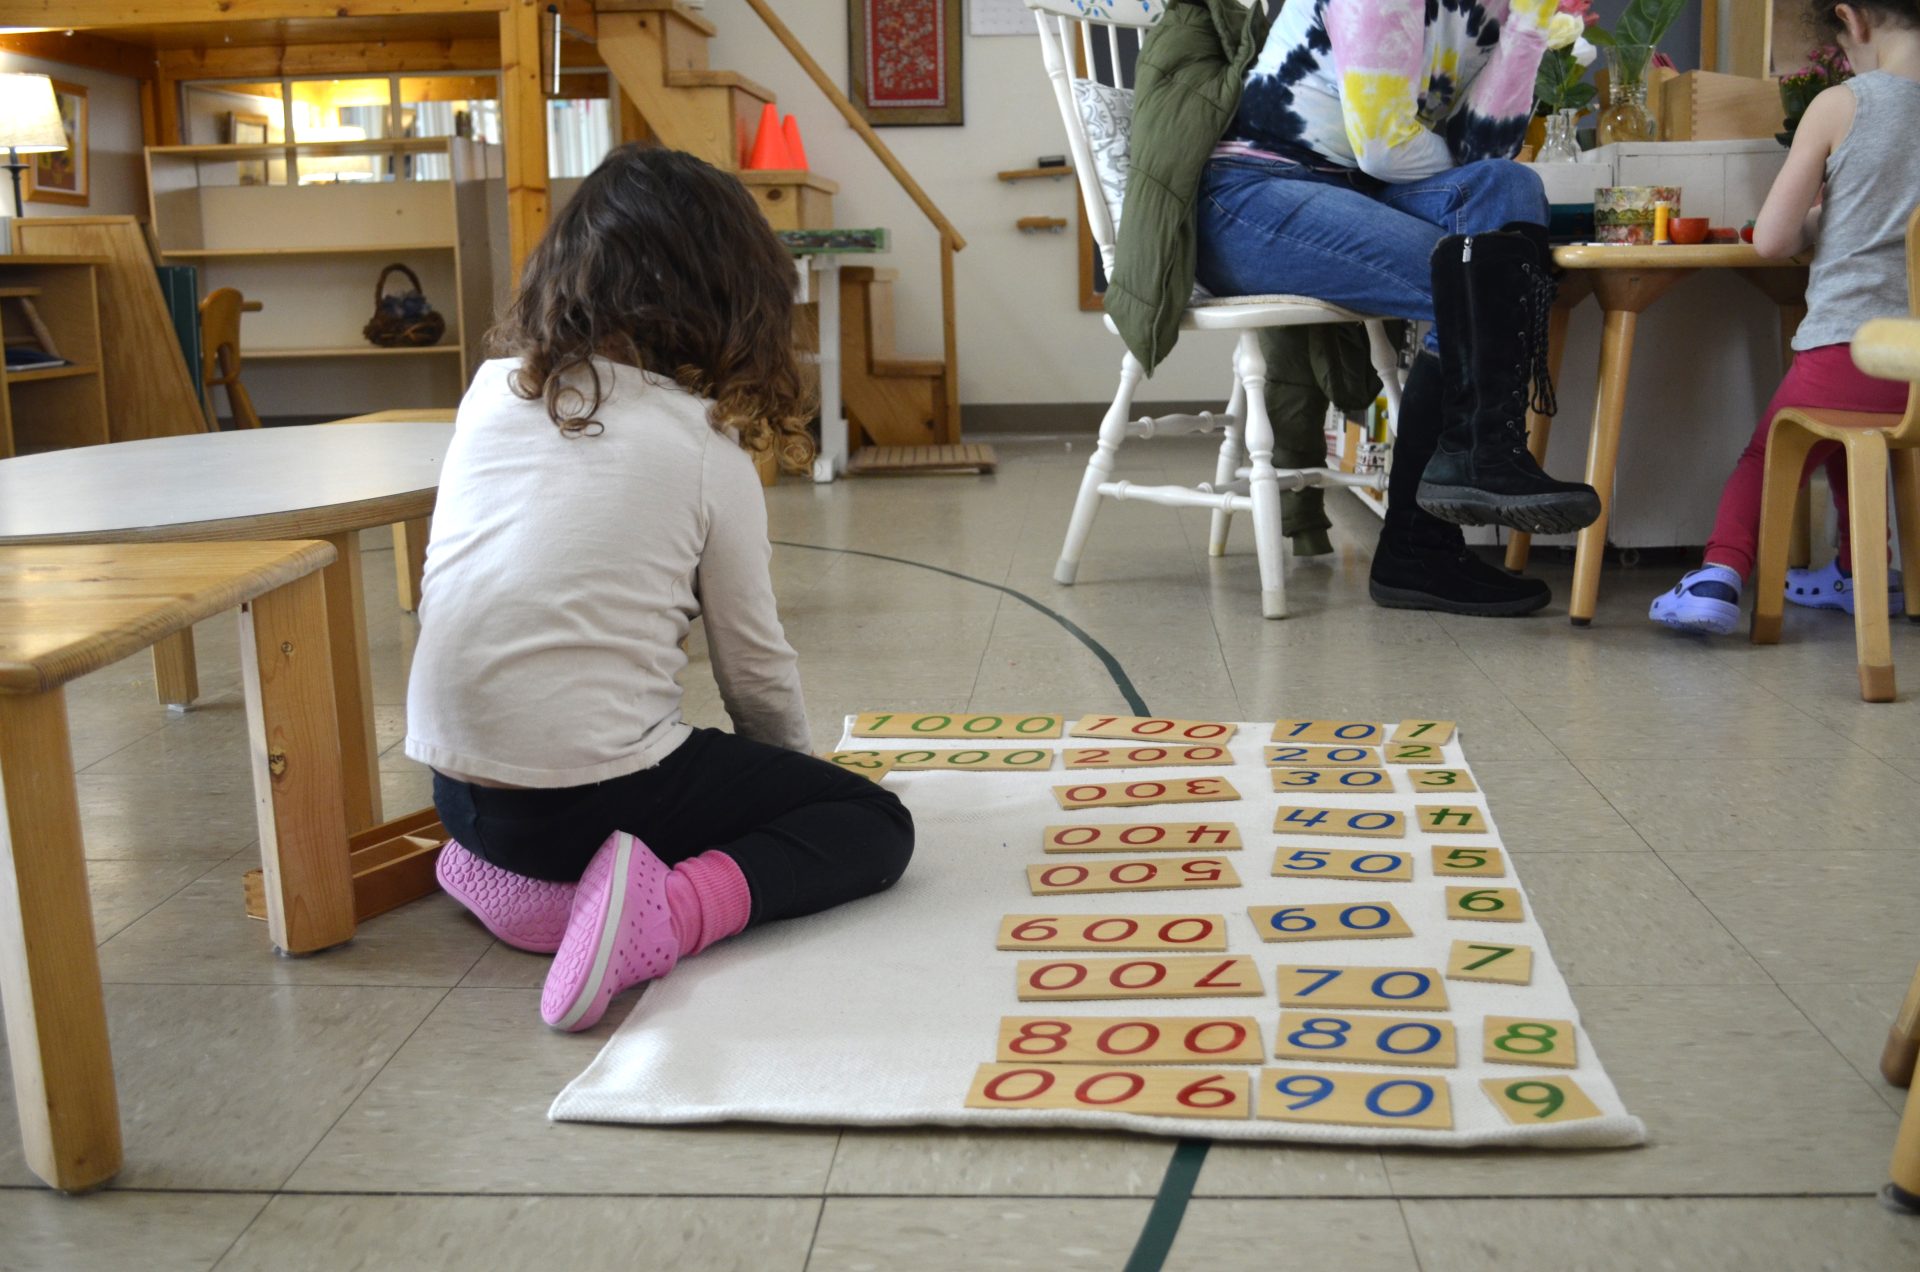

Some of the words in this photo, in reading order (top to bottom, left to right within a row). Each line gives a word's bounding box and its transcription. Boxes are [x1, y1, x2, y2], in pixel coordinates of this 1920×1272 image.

[868, 715, 1056, 733] 1000
[1086, 717, 1228, 739] 100
[1288, 722, 1376, 739] 10
[1408, 722, 1437, 738] 1
[1074, 746, 1223, 764] 200
[1272, 747, 1367, 762] 20
[1394, 744, 1432, 759] 2
[1281, 771, 1382, 786] 30
[1419, 770, 1457, 786] 3
[1066, 778, 1220, 802] 300
[1283, 809, 1395, 830] 40
[1429, 807, 1473, 826] 4
[1053, 825, 1232, 845] 400
[1282, 850, 1402, 874] 50
[1443, 849, 1487, 868] 5
[1040, 860, 1221, 887] 500
[1459, 890, 1504, 912] 6
[1271, 905, 1391, 932] 60
[1011, 917, 1214, 943] 600
[1461, 944, 1515, 971] 7
[1030, 959, 1242, 990] 700
[1294, 969, 1431, 999] 70
[1009, 1021, 1246, 1054] 800
[1287, 1017, 1442, 1055] 80
[1493, 1022, 1558, 1055] 8
[1275, 1074, 1435, 1117] 90
[1505, 1080, 1566, 1118] 9
